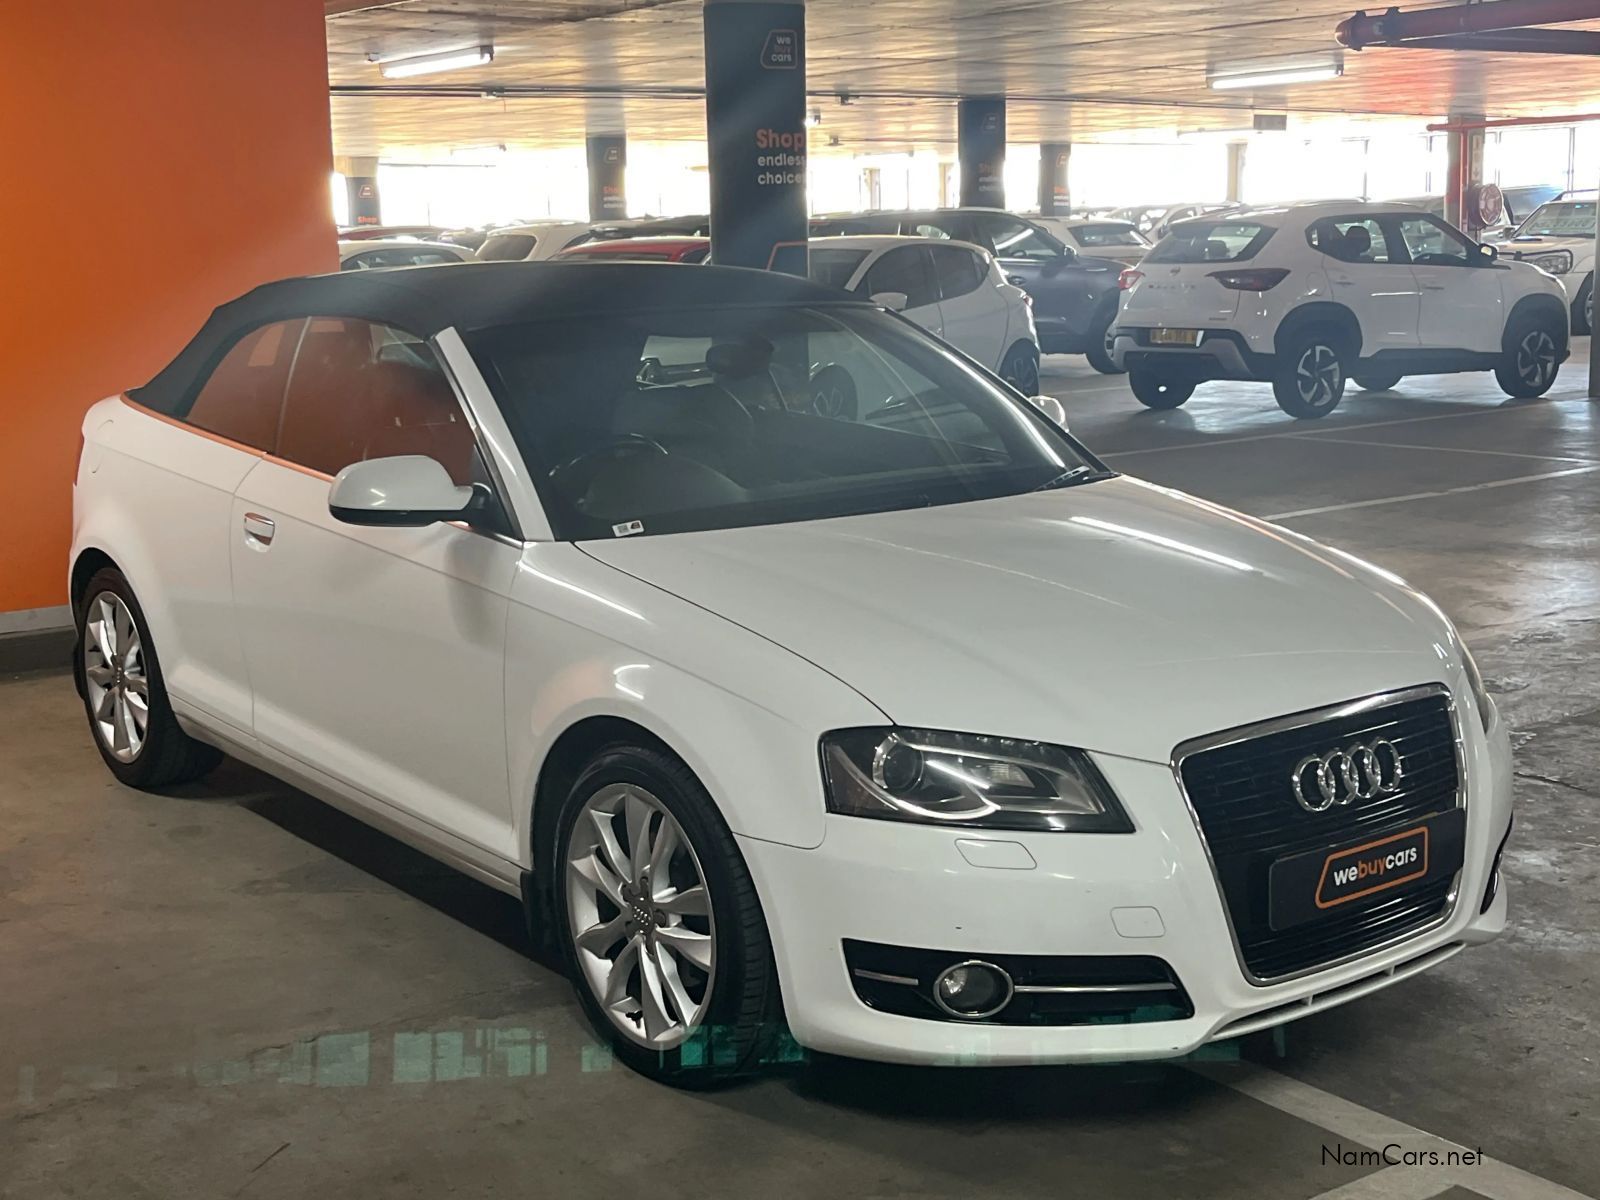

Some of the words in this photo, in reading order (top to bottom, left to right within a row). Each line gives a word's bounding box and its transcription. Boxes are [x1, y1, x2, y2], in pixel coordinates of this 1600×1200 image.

[776, 36, 791, 45] we
[771, 54, 792, 62] cars
[756, 129, 806, 152] Shop
[1333, 846, 1417, 886] webuycars
